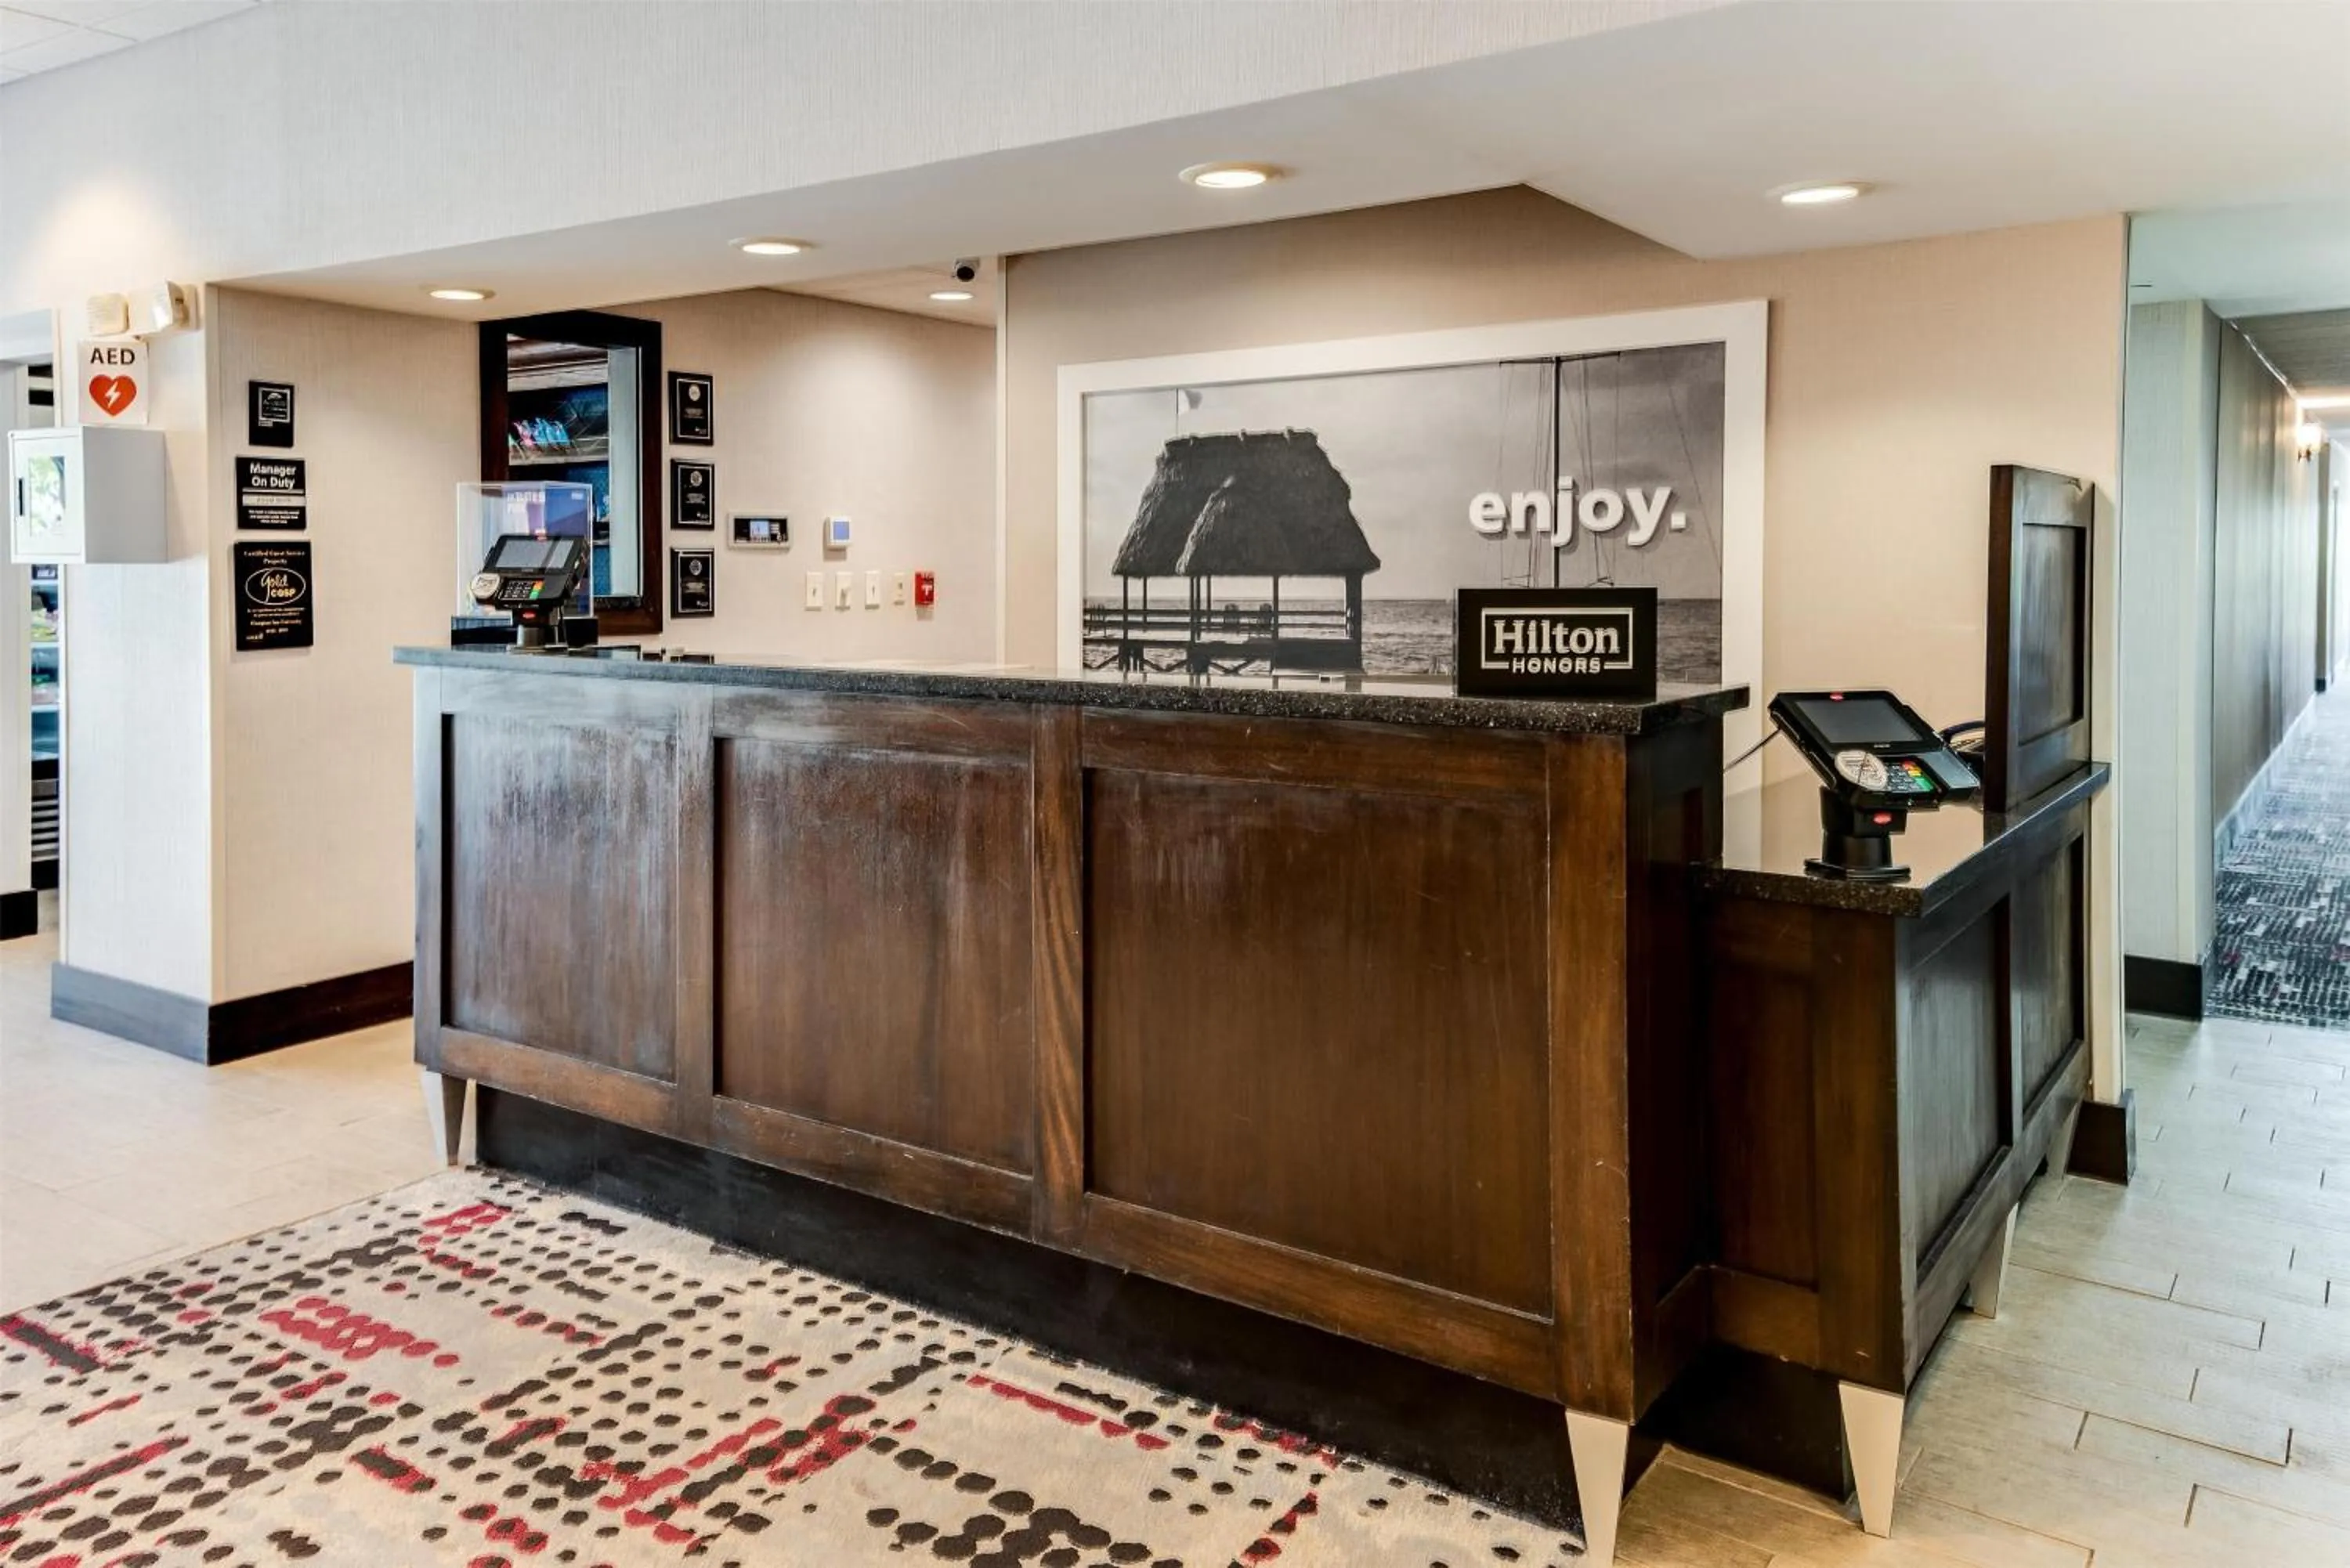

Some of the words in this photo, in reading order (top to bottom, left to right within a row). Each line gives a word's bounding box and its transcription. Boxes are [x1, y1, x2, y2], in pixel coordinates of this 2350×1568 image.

[90, 347, 136, 365] AED
[250, 462, 297, 477] Manager
[252, 475, 268, 487] On
[269, 476, 295, 490] Duty
[1469, 475, 1687, 547] enjoy.
[1493, 619, 1621, 655] Hilton
[1512, 656, 1601, 674] HONORS
